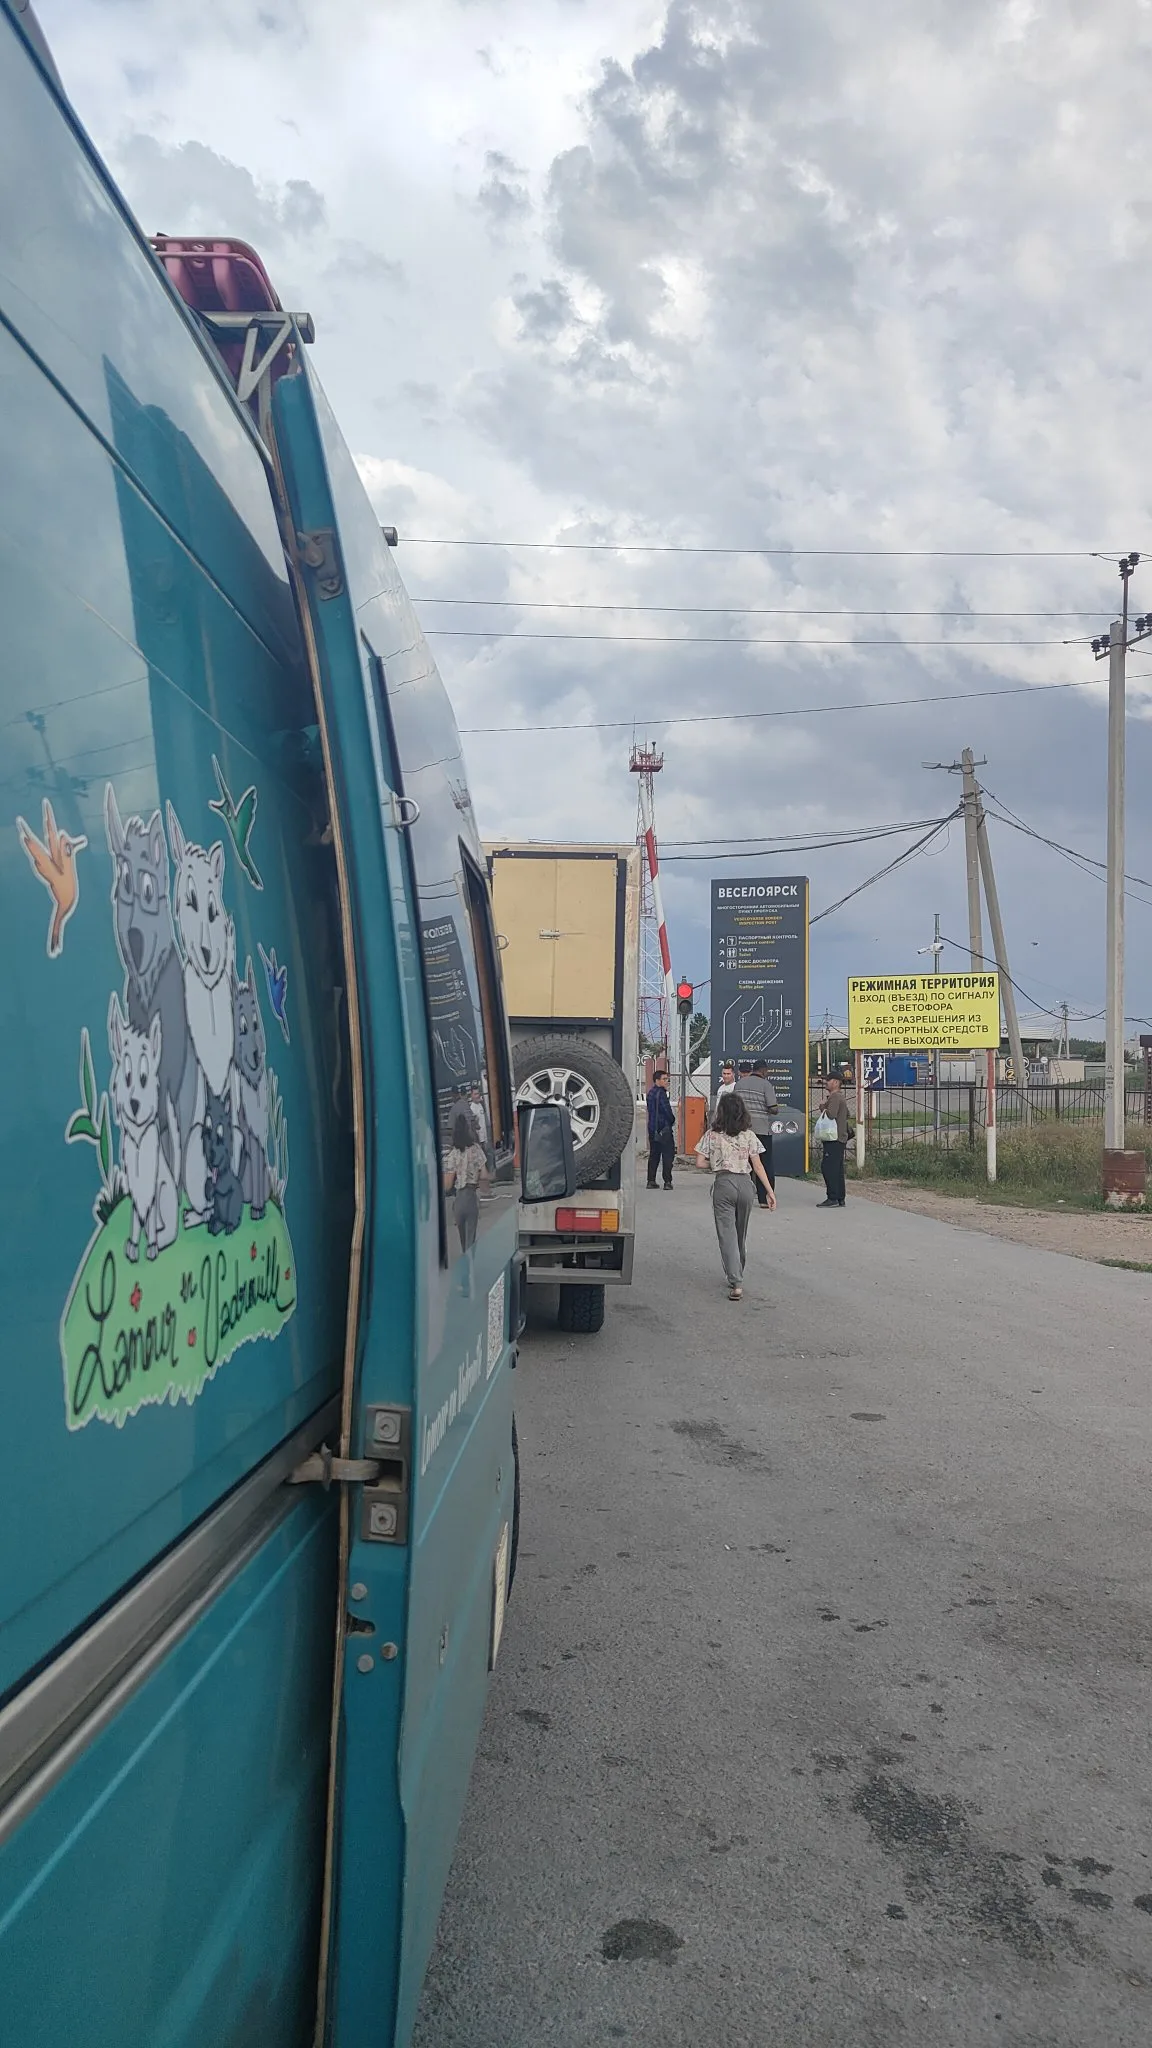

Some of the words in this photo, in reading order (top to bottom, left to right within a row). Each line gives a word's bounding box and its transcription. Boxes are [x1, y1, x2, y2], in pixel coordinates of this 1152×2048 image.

[718, 885, 798, 898] ВЕСЕЛОЯРСК
[852, 979, 916, 992] РЕЖИМНАЯ
[921, 976, 995, 990] ТЕРРИТОРИЯ
[852, 994, 886, 1003] 1.ВХОД
[888, 993, 928, 1003] (ВЪЕЗД)
[948, 991, 995, 1000] СИГНАЛУ
[892, 1004, 953, 1012] СВЕТОФОРА
[898, 1015, 965, 1023] РАЗРЕШЕНИЯ
[860, 1026, 939, 1035] ТРАНСПОРТНЫХ
[942, 1025, 988, 1034] СРЕДСТВ
[903, 1036, 959, 1045] ВЫХОДИТЬ
